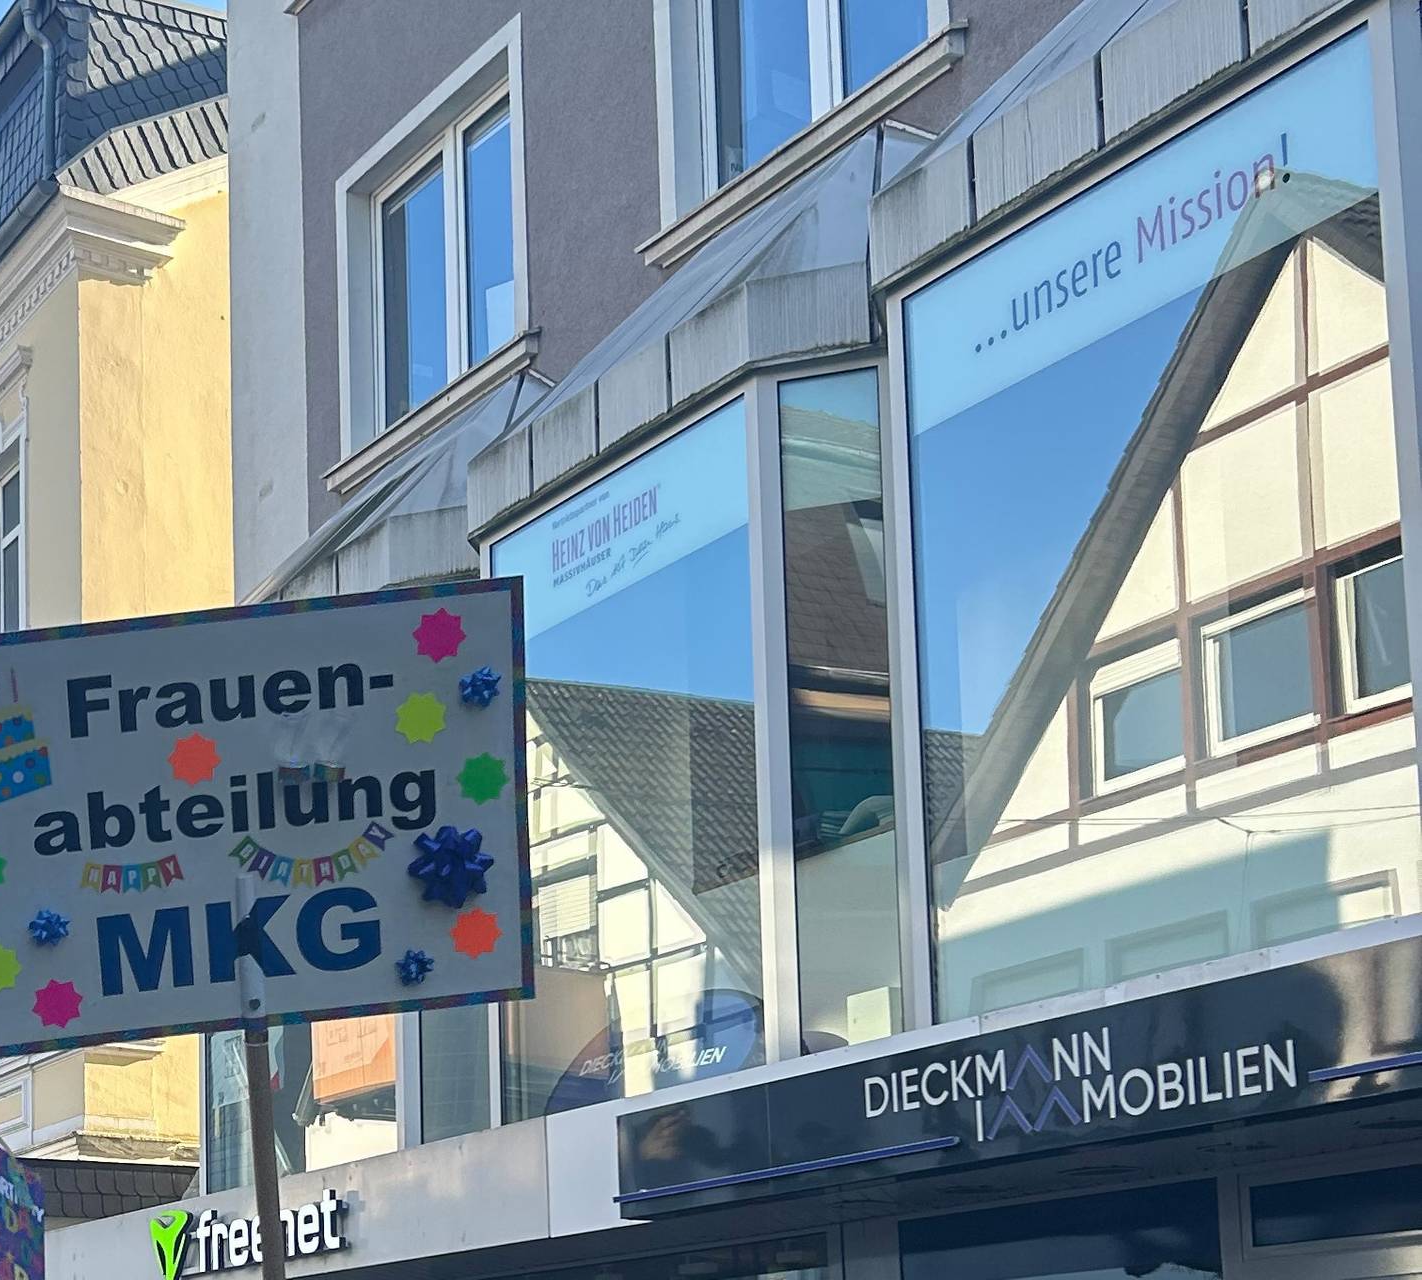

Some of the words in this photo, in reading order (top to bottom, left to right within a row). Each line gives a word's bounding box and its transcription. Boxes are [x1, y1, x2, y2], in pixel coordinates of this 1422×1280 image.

[1136, 132, 1289, 264] Mission!
[552, 530, 585, 573] HEINZ
[587, 514, 611, 551] VON
[613, 487, 658, 538] HEIDEN
[66, 661, 394, 739] Frauen-
[33, 768, 436, 857] abteilung
[88, 861, 175, 886] HAPPY
[239, 825, 386, 878] BIRTHDAY
[96, 885, 384, 998] MKG
